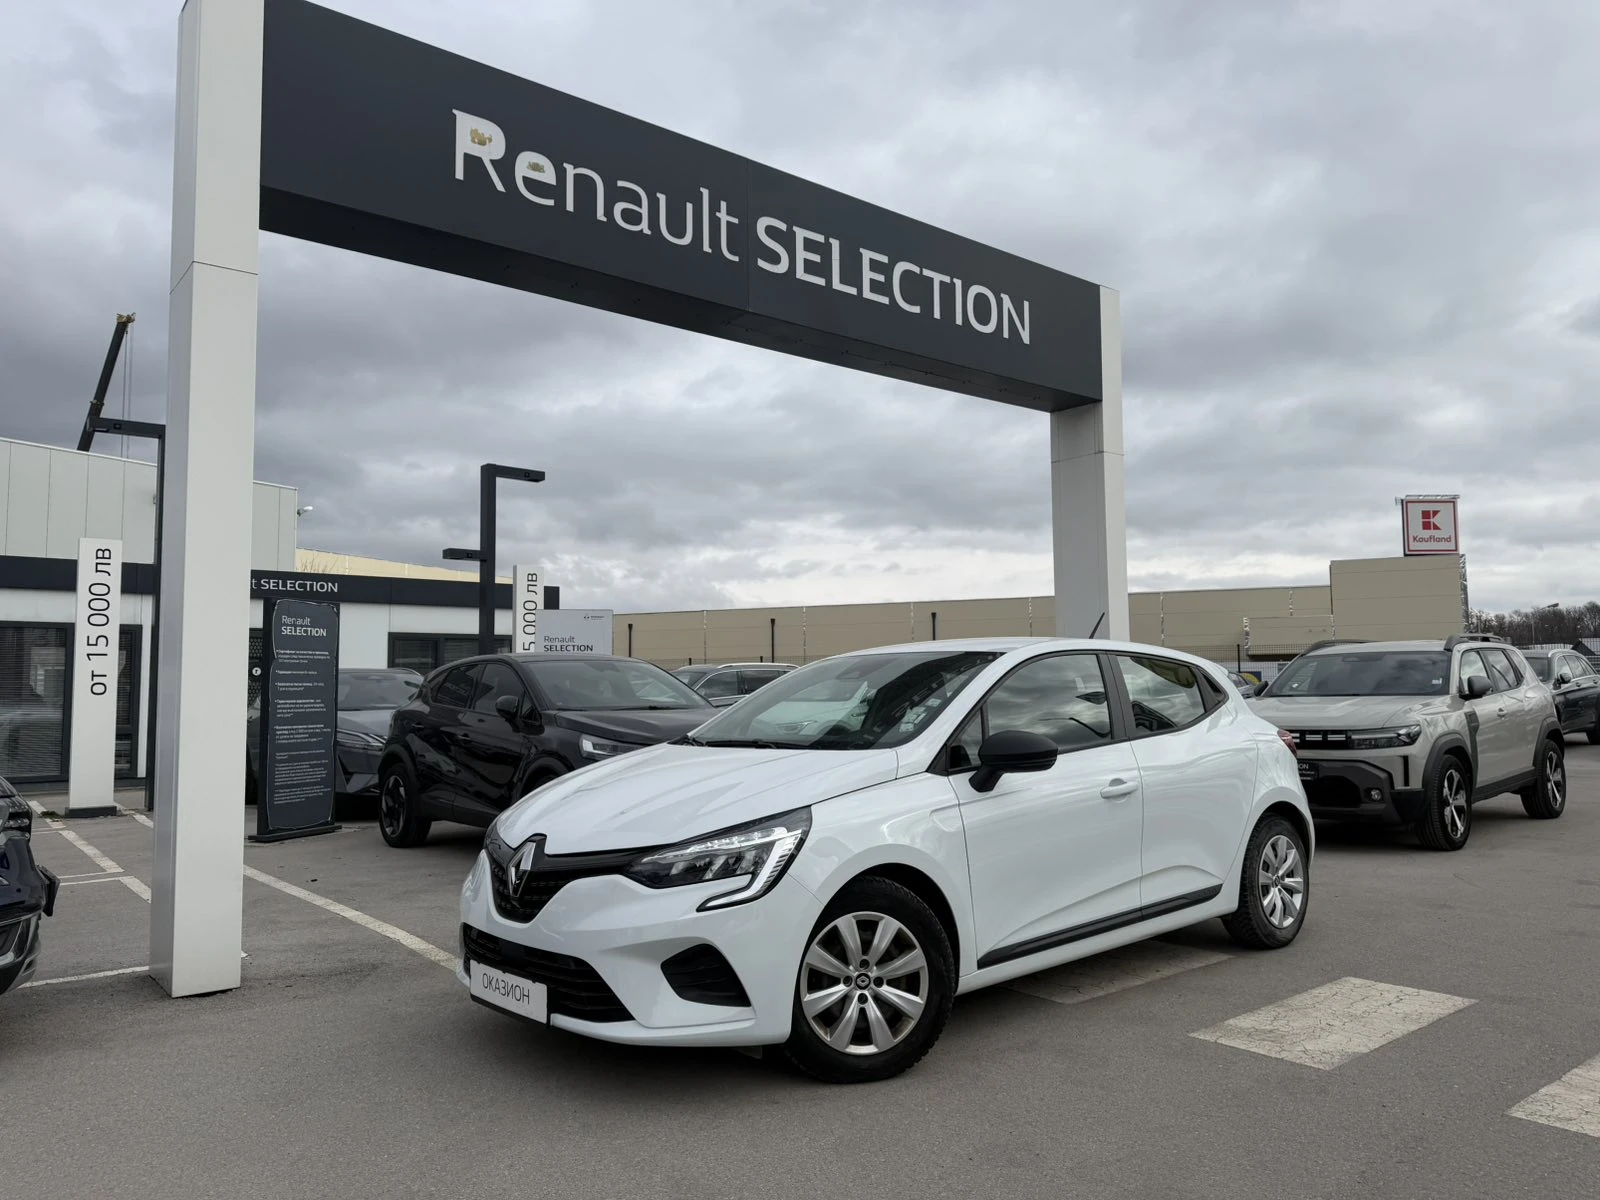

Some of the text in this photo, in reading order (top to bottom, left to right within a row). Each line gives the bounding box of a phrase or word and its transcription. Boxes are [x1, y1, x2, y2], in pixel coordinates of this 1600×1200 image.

[452, 108, 1031, 345] Renault SELECTION
[1412, 535, 1451, 543] Kaufland
[260, 578, 339, 593] SELECTION
[87, 582, 111, 627] 000
[281, 615, 311, 626] Renault
[281, 626, 327, 637] SELECTION
[544, 635, 576, 644] Renault
[86, 634, 109, 661] 15
[544, 644, 593, 652] SELECTION
[482, 972, 530, 1005] ОКАЗИОН
